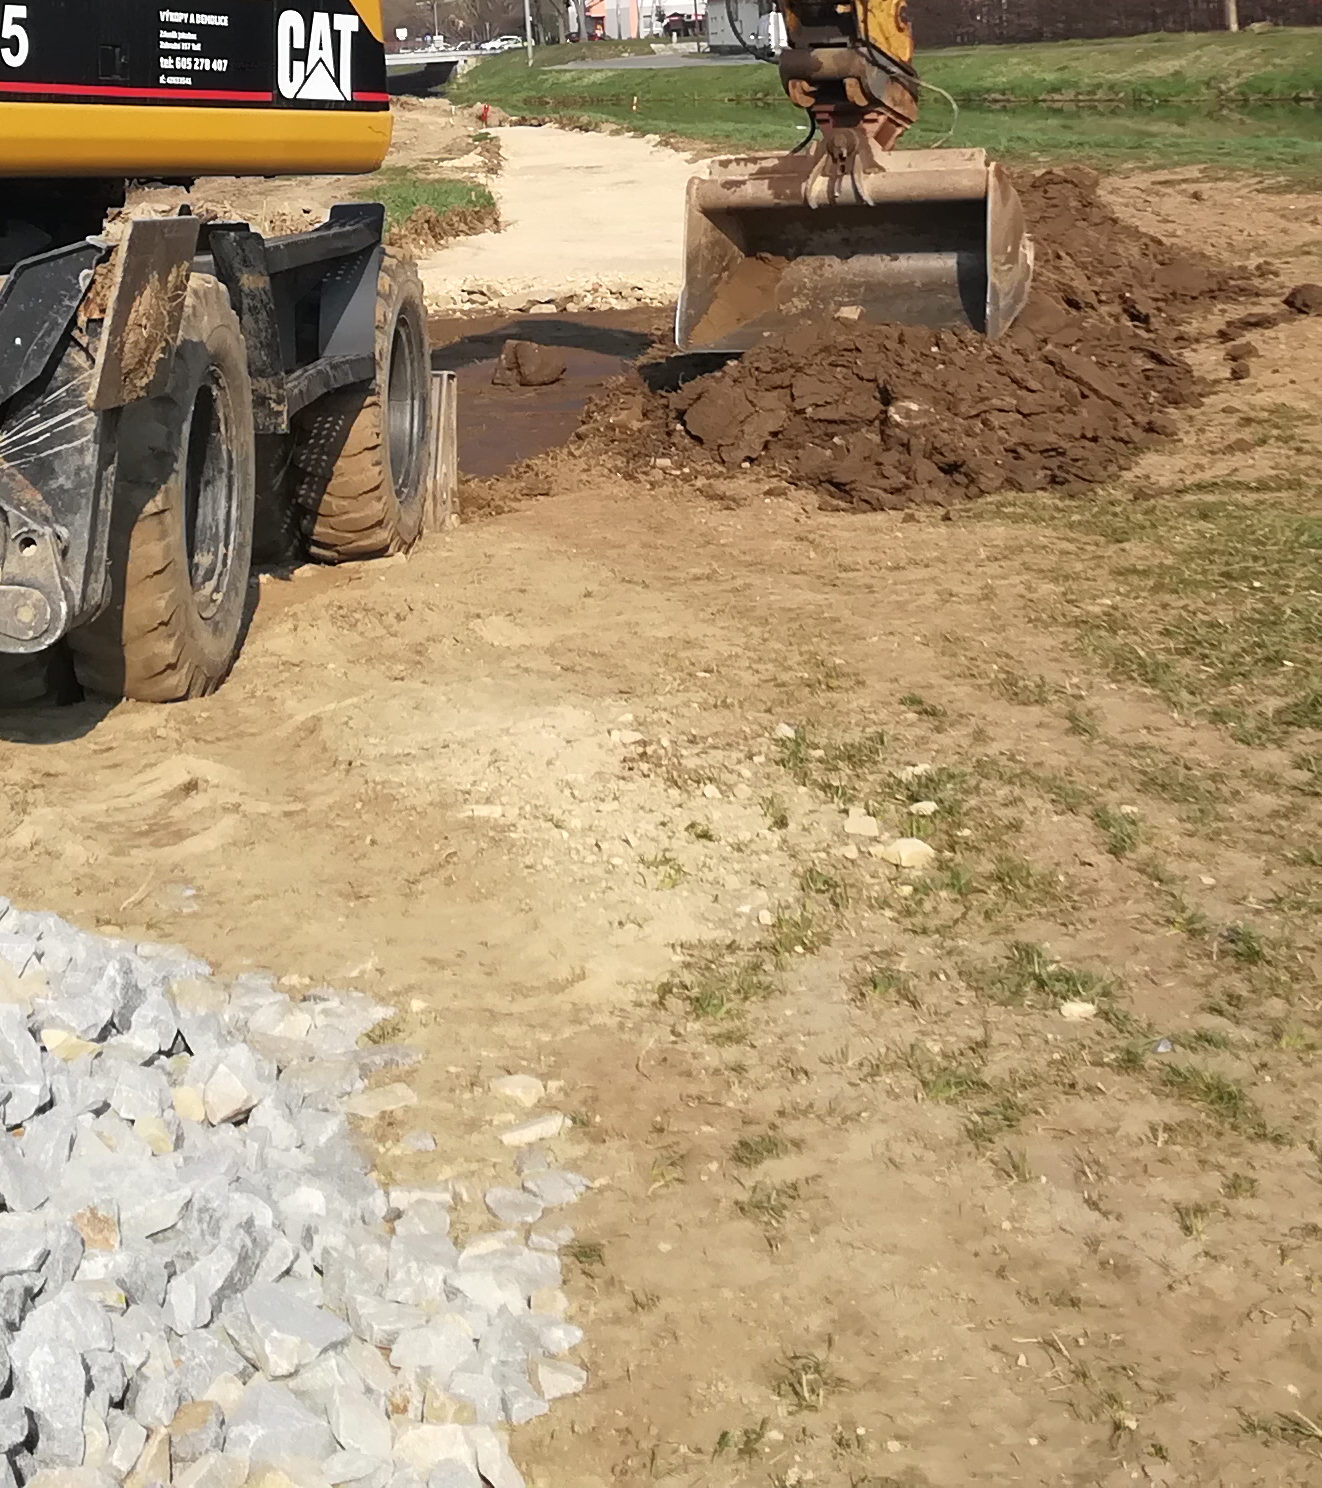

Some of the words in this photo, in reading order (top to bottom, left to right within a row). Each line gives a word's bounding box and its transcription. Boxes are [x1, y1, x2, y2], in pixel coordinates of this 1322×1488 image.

[175, 56, 193, 70] 605
[211, 58, 228, 72] 407
[277, 10, 359, 102] CAT
